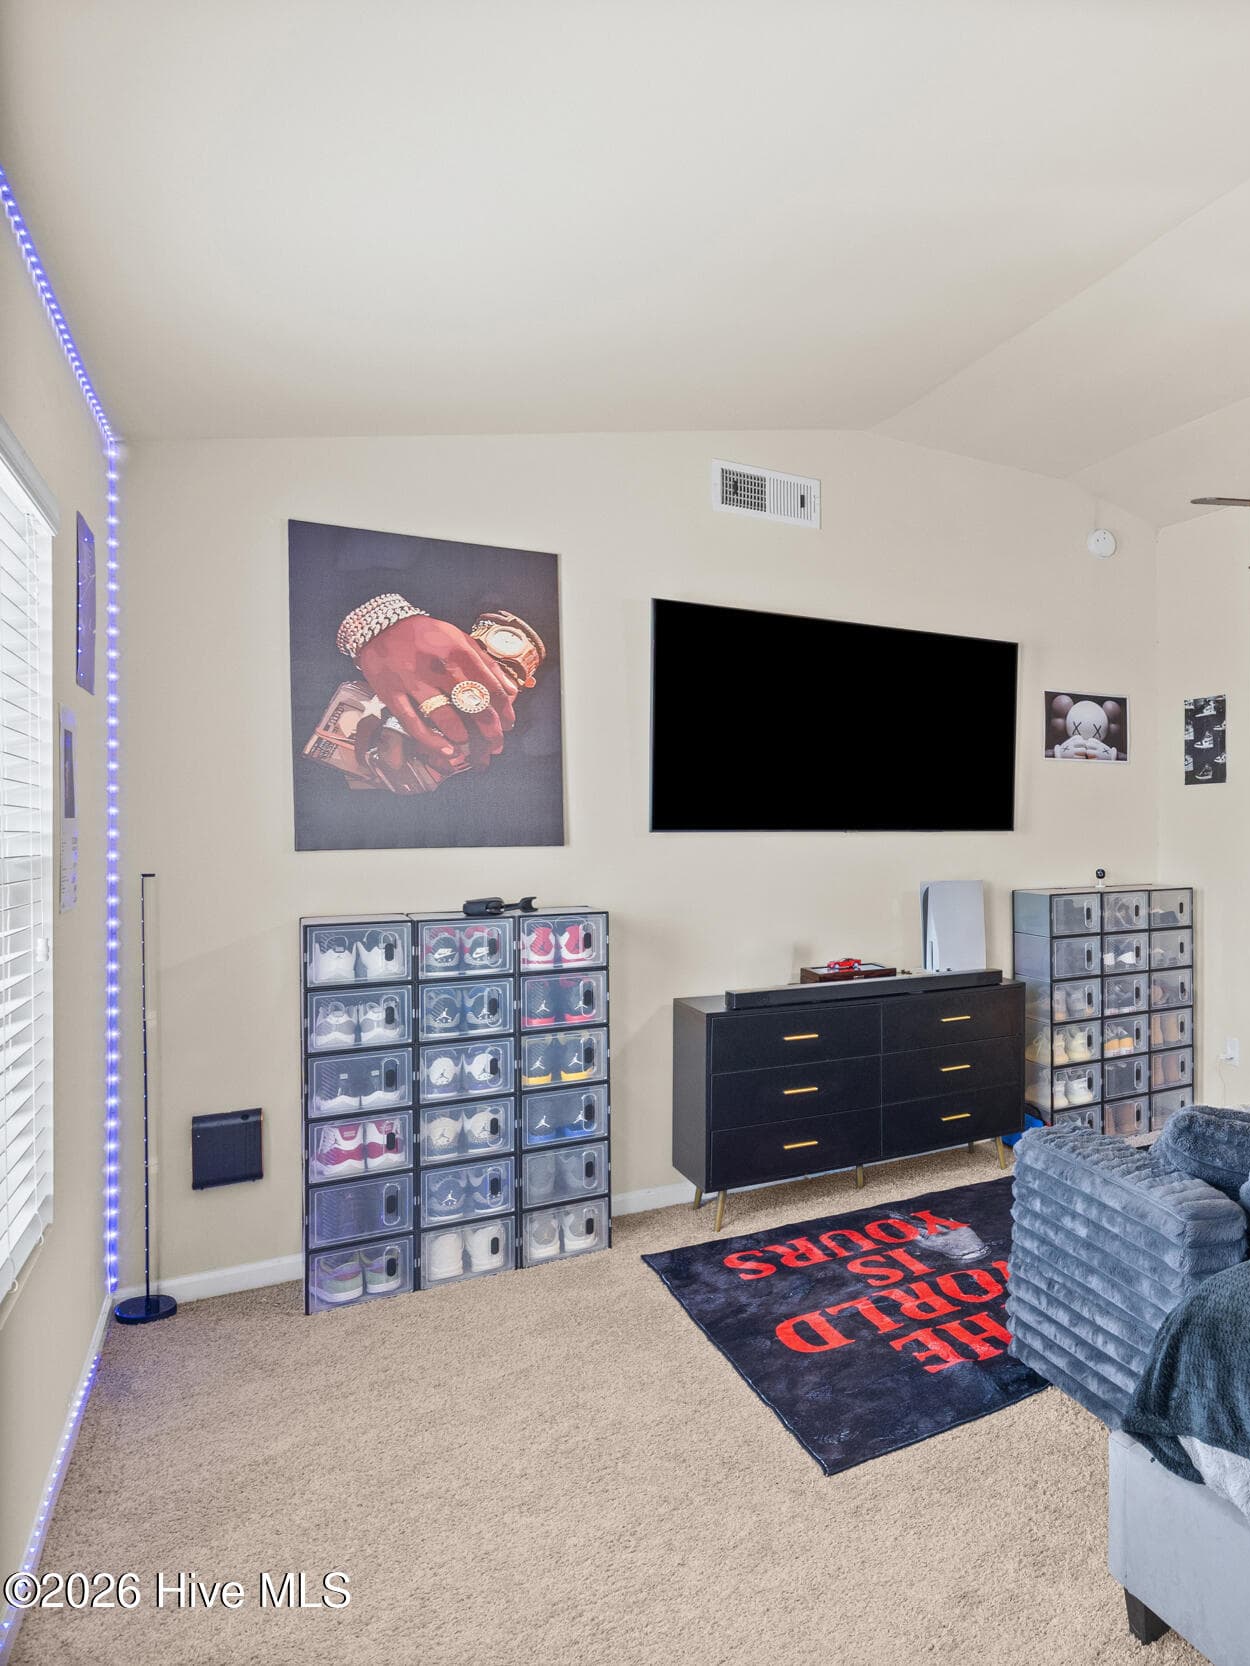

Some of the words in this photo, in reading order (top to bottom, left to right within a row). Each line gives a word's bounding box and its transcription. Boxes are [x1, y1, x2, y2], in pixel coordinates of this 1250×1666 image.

[723, 1209, 970, 1281] YOURS
[847, 1247, 936, 1287] IS
[774, 1260, 1012, 1354] ORLD
[889, 1311, 1014, 1374] HE
